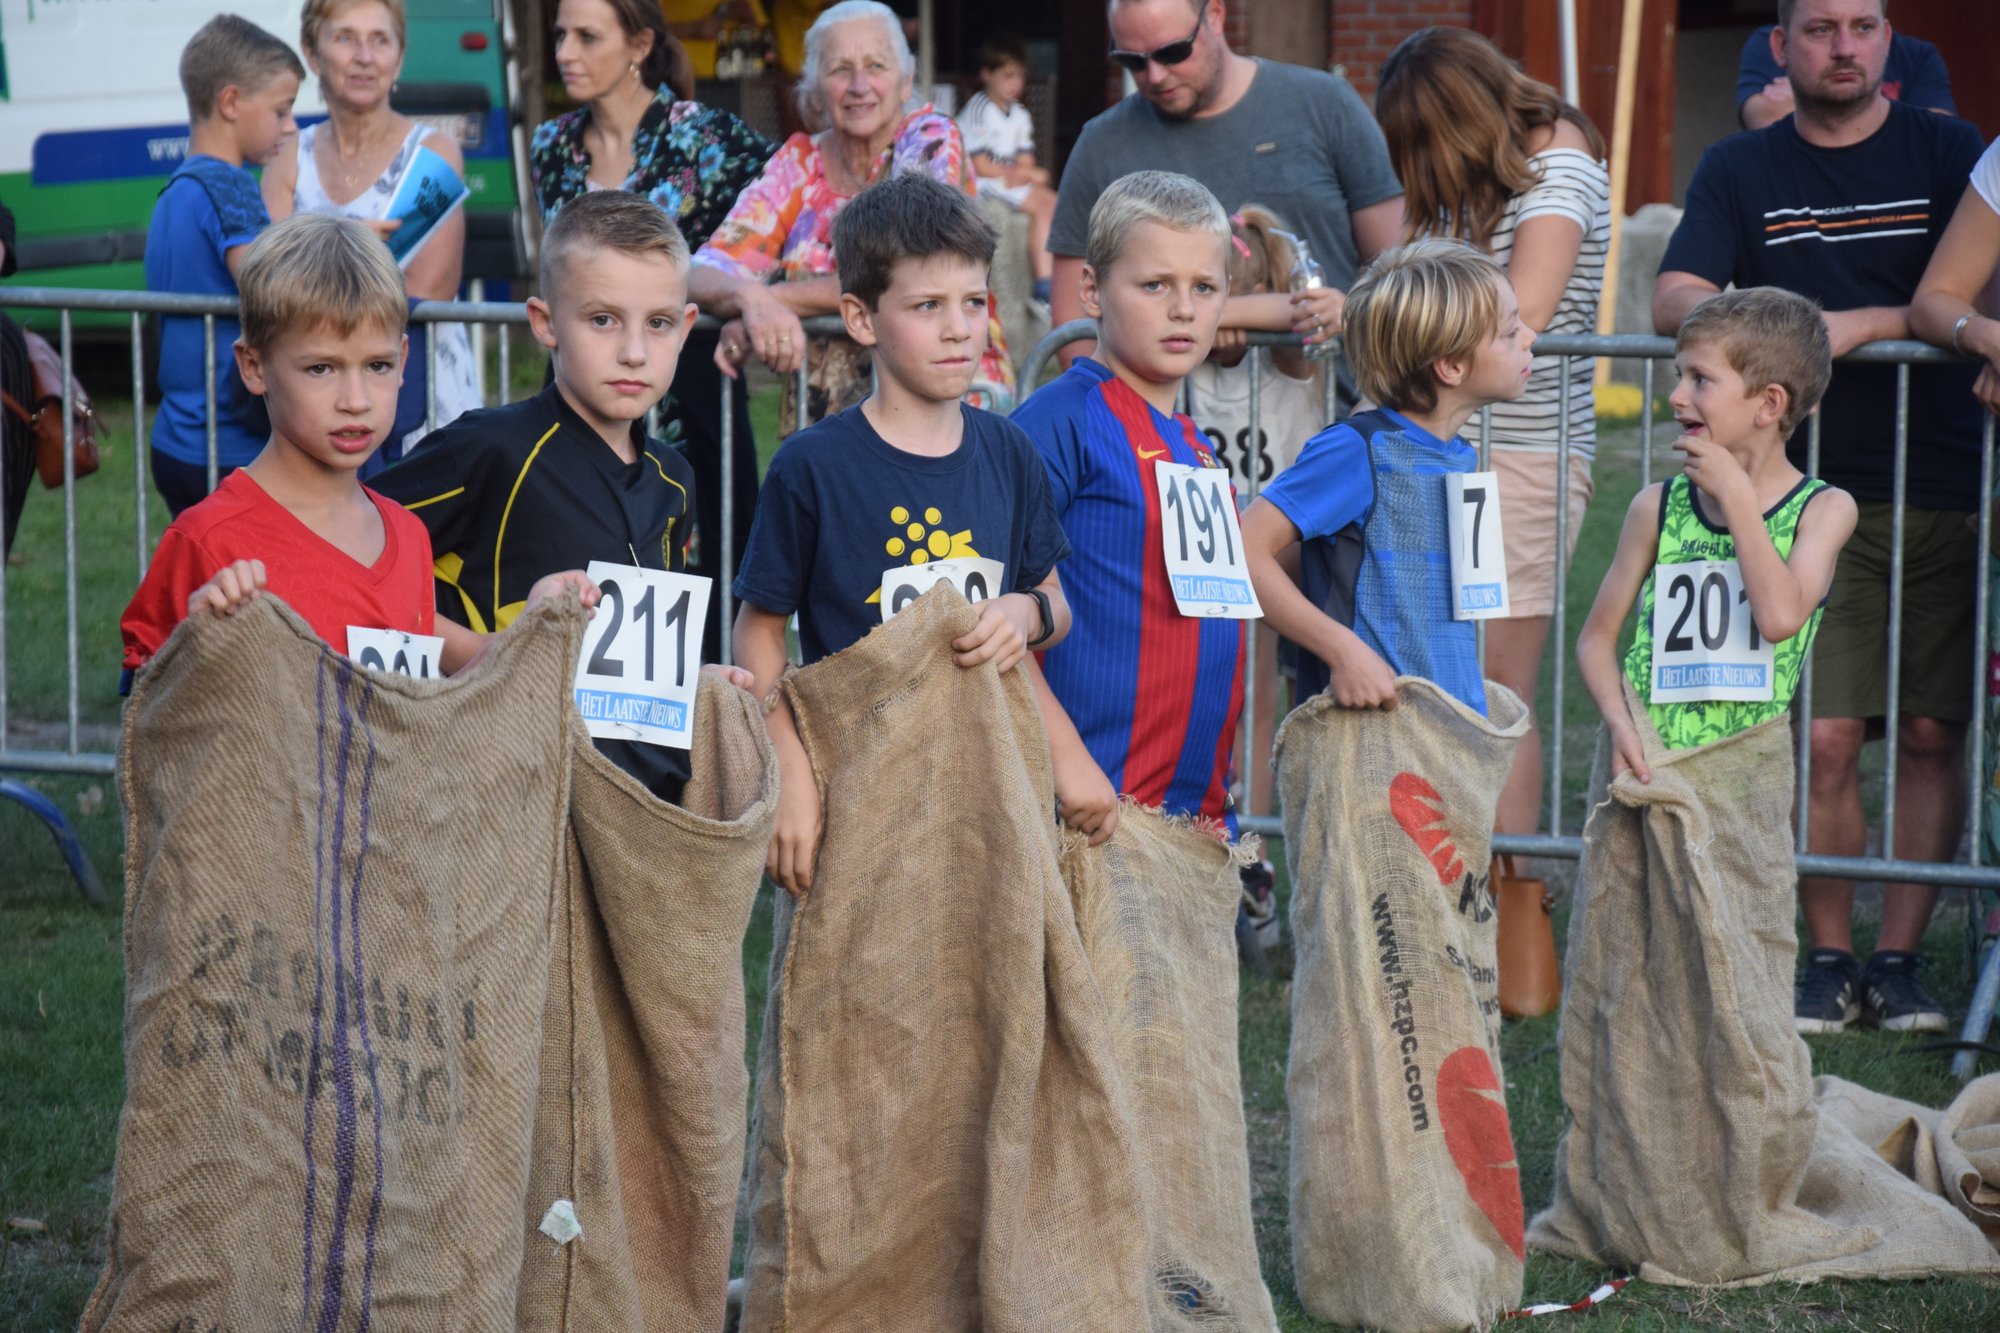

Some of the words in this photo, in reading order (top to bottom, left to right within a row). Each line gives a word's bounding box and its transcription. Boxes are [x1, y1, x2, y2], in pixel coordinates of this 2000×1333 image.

[1167, 475, 1235, 566] 191
[1463, 487, 1487, 569] 7
[1174, 576, 1189, 599] HET
[1190, 577, 1221, 601] LAATSTE
[1220, 580, 1249, 603] NIEUWS
[587, 578, 691, 687] 211
[581, 691, 604, 718] HET
[604, 694, 651, 722] LAATSTE
[648, 700, 682, 729] NIEUWS
[1662, 667, 1681, 688] HET
[1682, 666, 1721, 687] LAATSTE
[1722, 664, 1761, 686] NIEUWS
[1371, 893, 1429, 1133] www.hzpc.com
